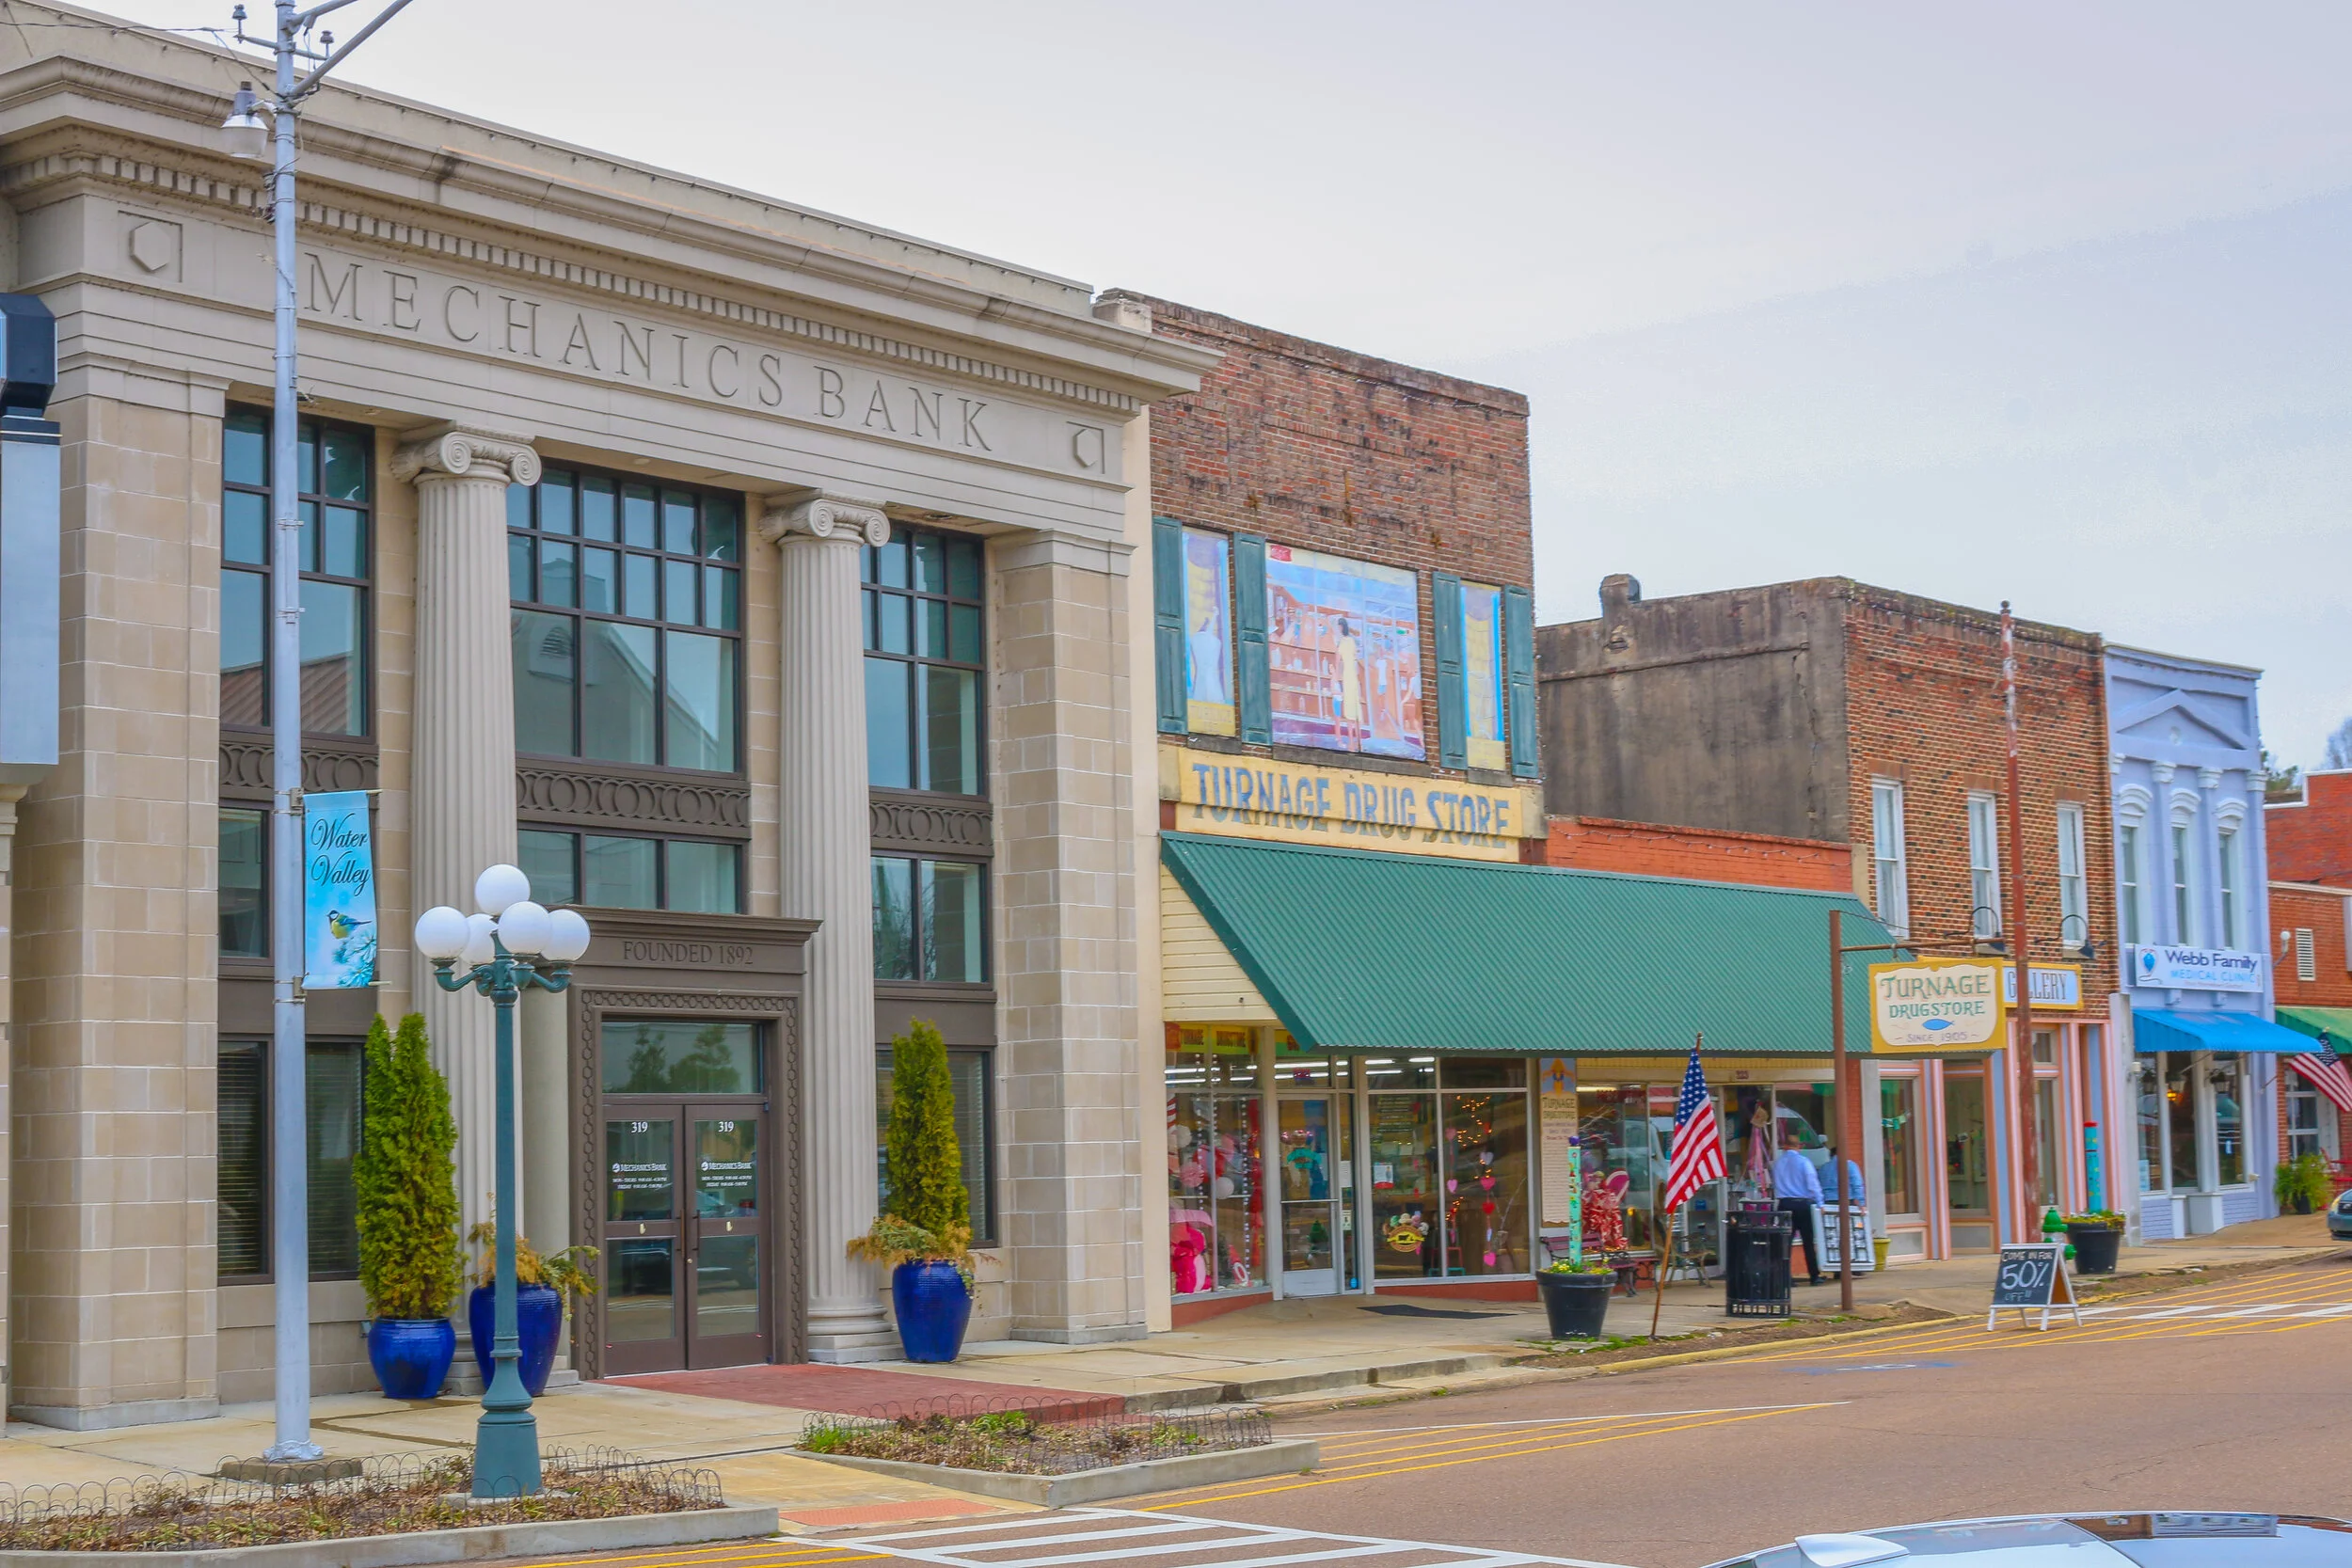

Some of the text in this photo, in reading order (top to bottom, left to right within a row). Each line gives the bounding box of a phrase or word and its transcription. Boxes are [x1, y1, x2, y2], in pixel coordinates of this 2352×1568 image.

[304, 252, 993, 452] MECHANICS BANK
[1192, 763, 1510, 849] TURNAGE DRUG STORE
[310, 813, 368, 851] Water
[310, 850, 371, 897] Valley
[623, 941, 754, 965] FOUNDED 1892
[2165, 949, 2258, 974] Webb Family
[1880, 974, 1992, 999] TURNAGE
[2008, 971, 2068, 1001] GLERY
[1889, 1000, 1986, 1020] DRUGSTORE
[1907, 1031, 1968, 1043] SINCE 1905
[630, 1121, 649, 1133] 319
[718, 1120, 735, 1132] 319
[2001, 1251, 2026, 1261] COME
[2001, 1260, 2050, 1290] 50%
